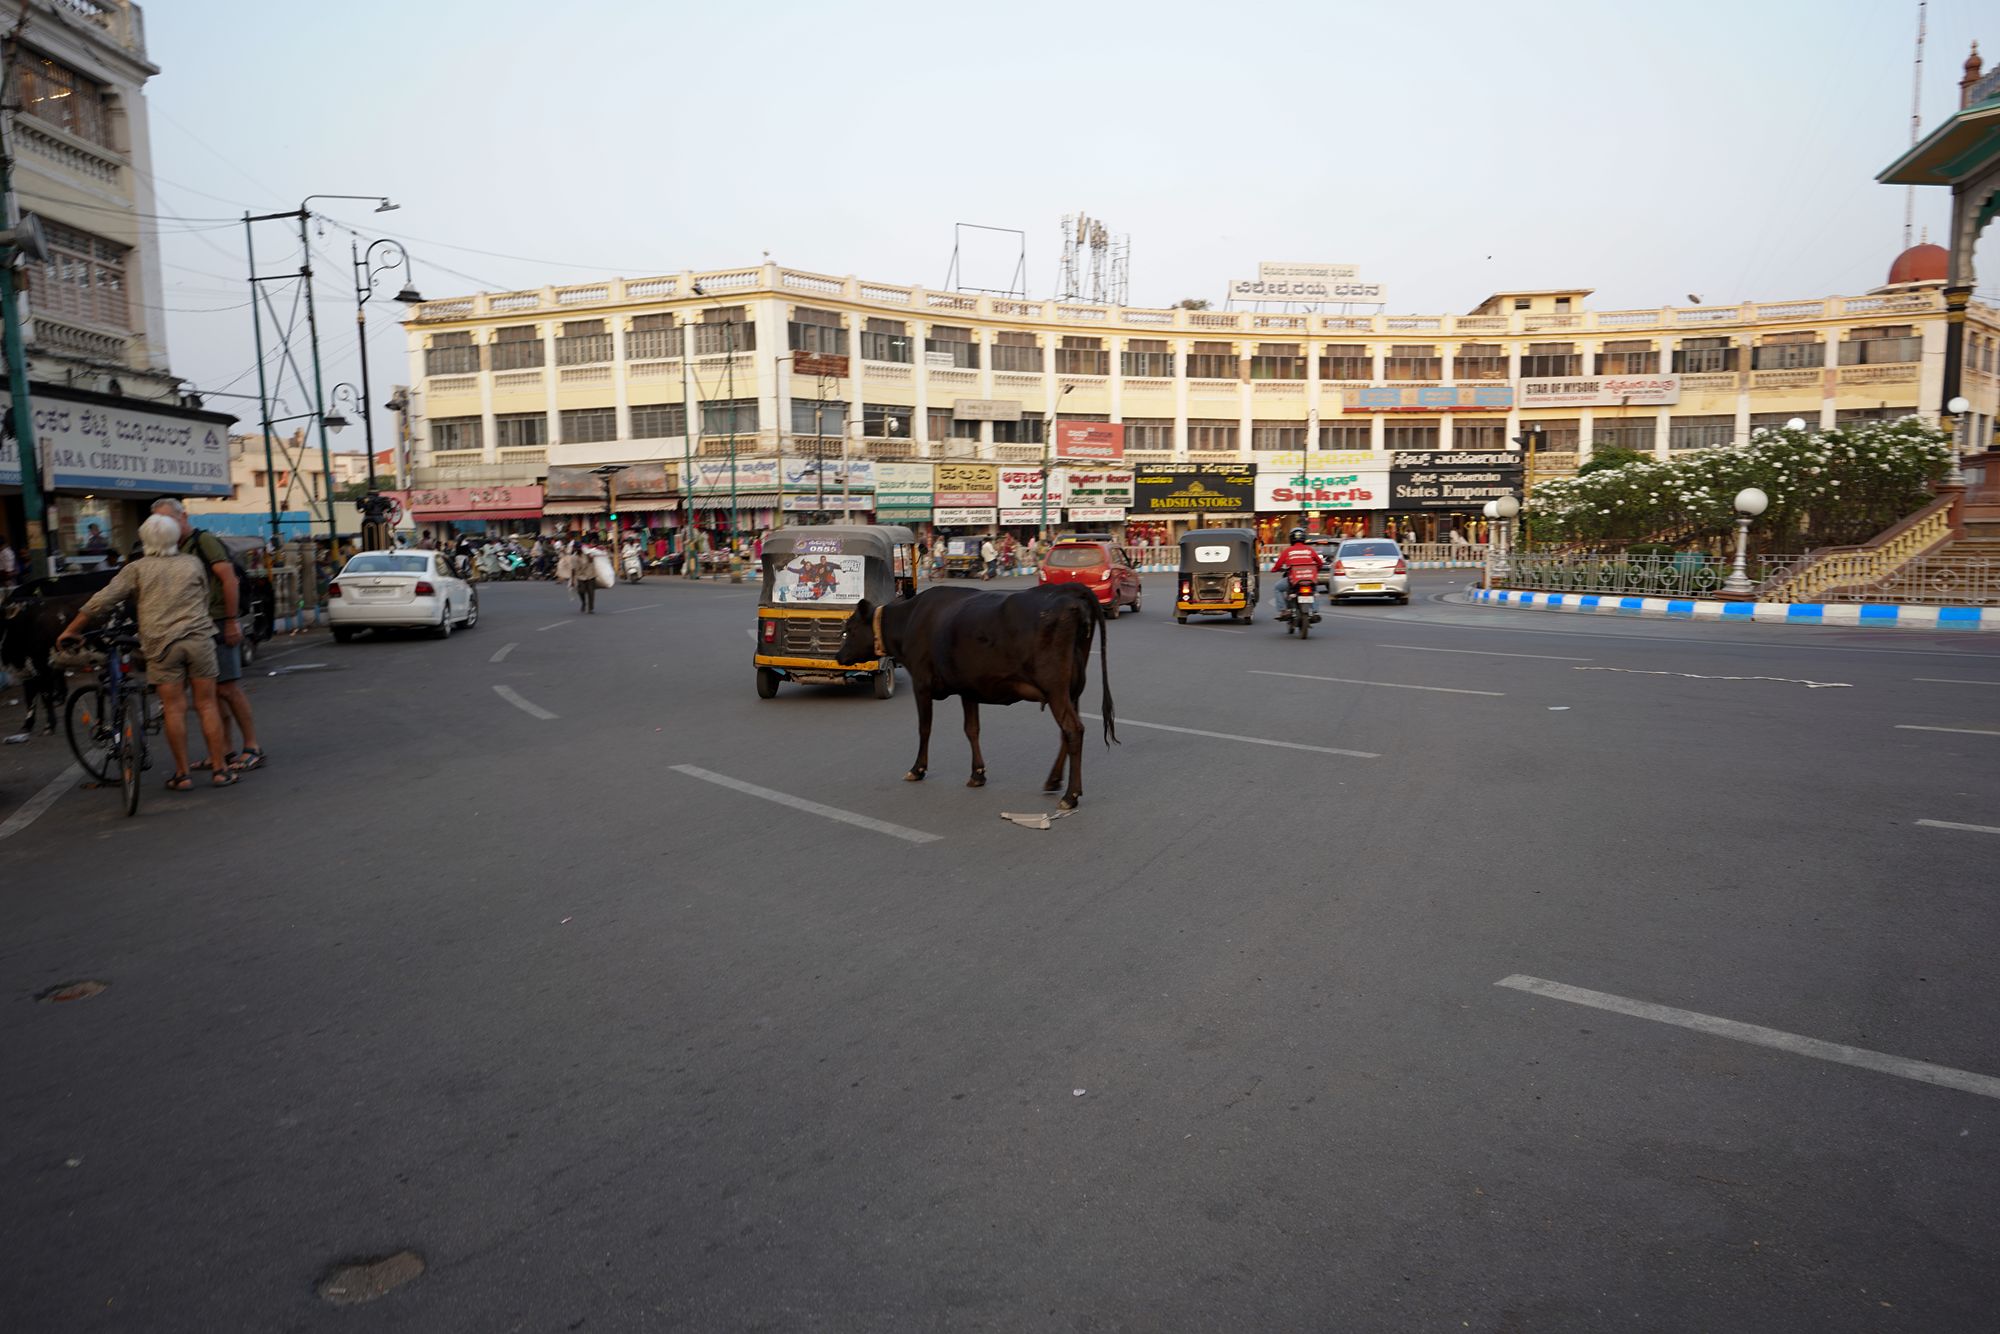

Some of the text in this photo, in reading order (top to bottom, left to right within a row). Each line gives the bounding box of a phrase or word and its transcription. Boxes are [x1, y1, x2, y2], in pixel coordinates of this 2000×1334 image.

[1334, 283, 1379, 297] ಭವನ
[1526, 381, 1600, 395] STAR OF MYSORE
[90, 451, 149, 474] CHETTY
[152, 457, 224, 479] JEWELLERS
[1396, 485, 1515, 500] States Emporium
[1150, 497, 1243, 508] BADSHA STORES
